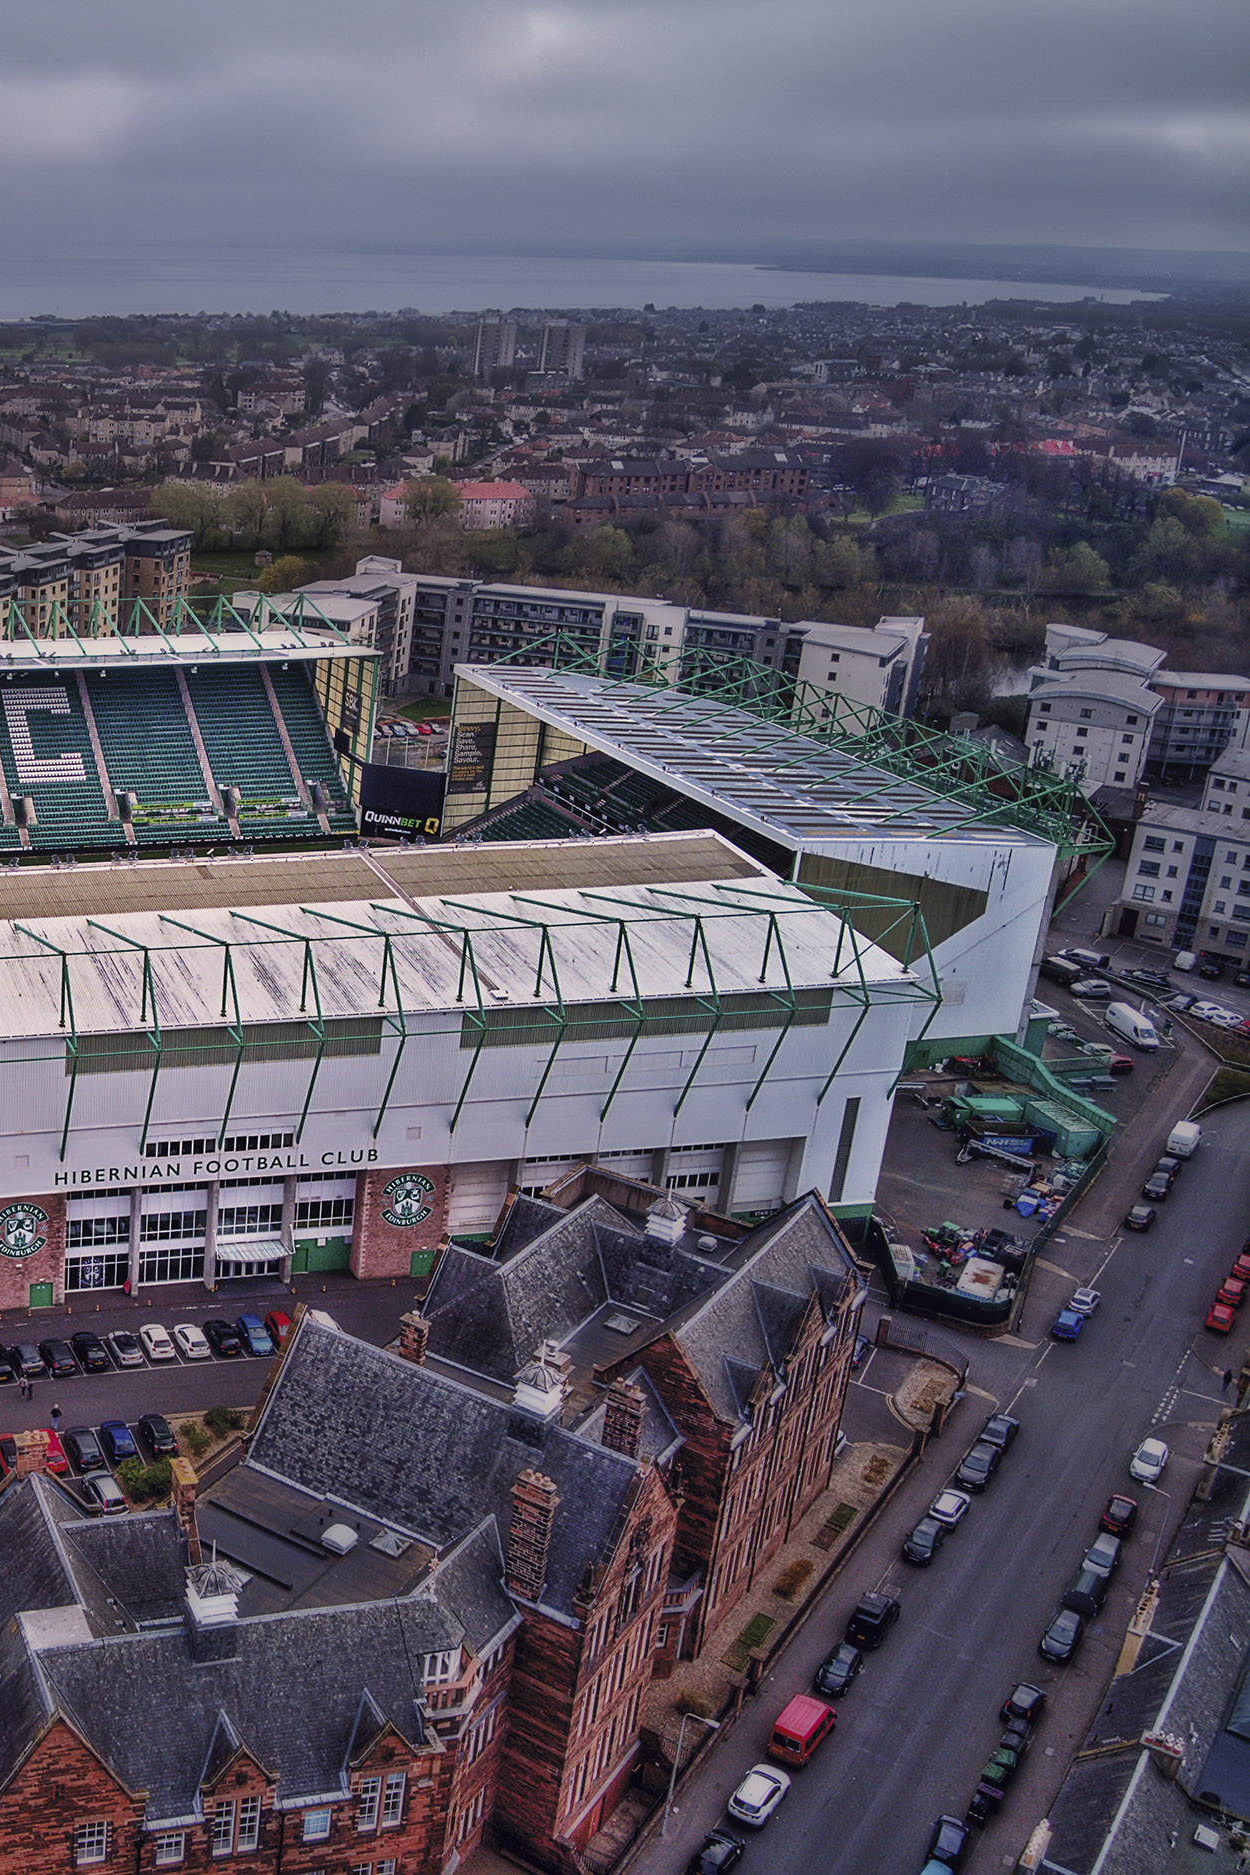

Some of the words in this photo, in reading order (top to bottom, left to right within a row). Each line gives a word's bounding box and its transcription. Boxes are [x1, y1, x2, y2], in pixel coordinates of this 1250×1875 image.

[345, 690, 359, 712] SBK
[454, 756, 480, 764] Savour.
[364, 810, 422, 828] QUINNBET
[54, 1163, 180, 1185] HIBERNIAN
[194, 1154, 309, 1174] FOOTBALL
[322, 1149, 378, 1165] CLUB
[385, 1175, 432, 1193] HIBERNIAN
[385, 1210, 428, 1226] EDINBURGH
